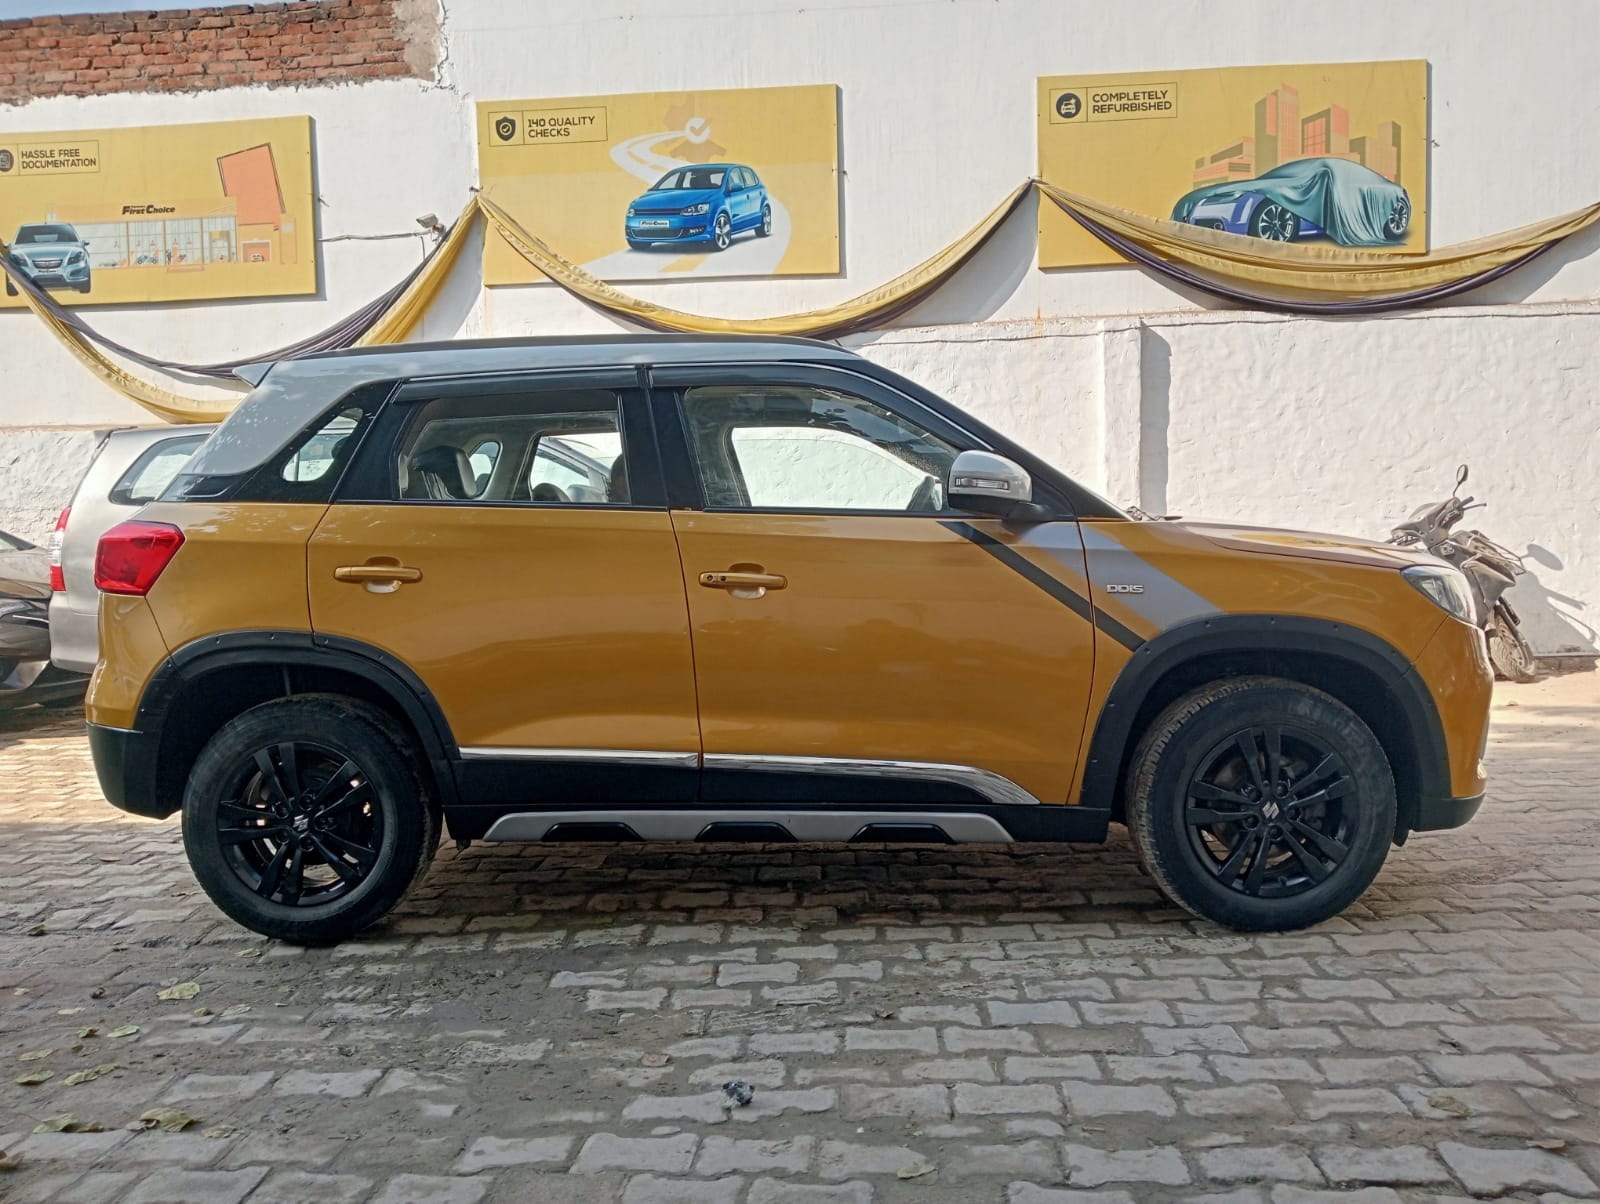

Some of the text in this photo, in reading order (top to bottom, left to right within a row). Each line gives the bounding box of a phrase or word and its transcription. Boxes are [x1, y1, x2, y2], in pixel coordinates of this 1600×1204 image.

[1092, 90, 1168, 103] COMPLETELY
[1092, 101, 1172, 114] REFURBISHED
[528, 116, 595, 128] 140 QUALITY
[528, 128, 570, 138] CHECKS
[21, 148, 80, 159] HASSLE FREE
[21, 158, 97, 169] DOCUMENTATION
[146, 204, 176, 214] Choice
